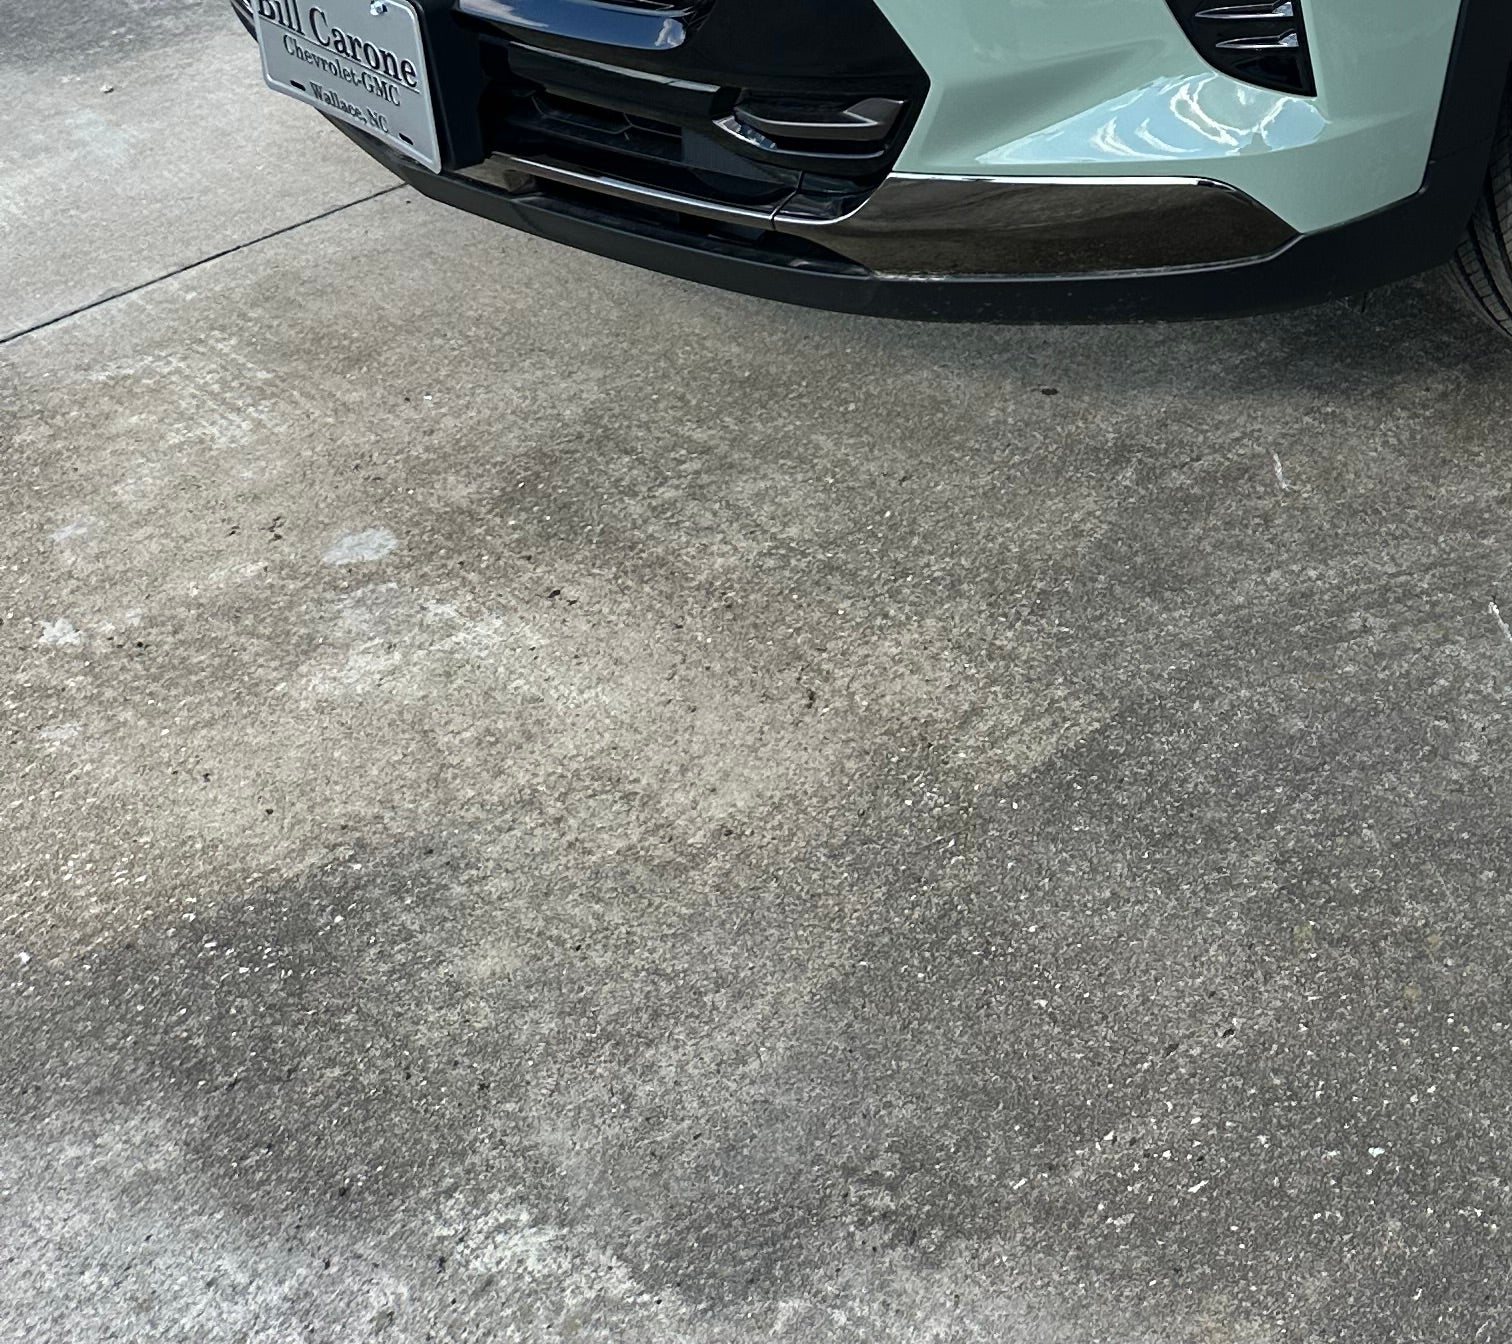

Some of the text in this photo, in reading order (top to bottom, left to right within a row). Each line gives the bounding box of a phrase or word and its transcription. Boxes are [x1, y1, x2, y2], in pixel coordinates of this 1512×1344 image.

[283, 34, 401, 106] Chevrolet-GMC
[308, 6, 418, 88] Carone
[309, 80, 389, 133] Wallace, NC
